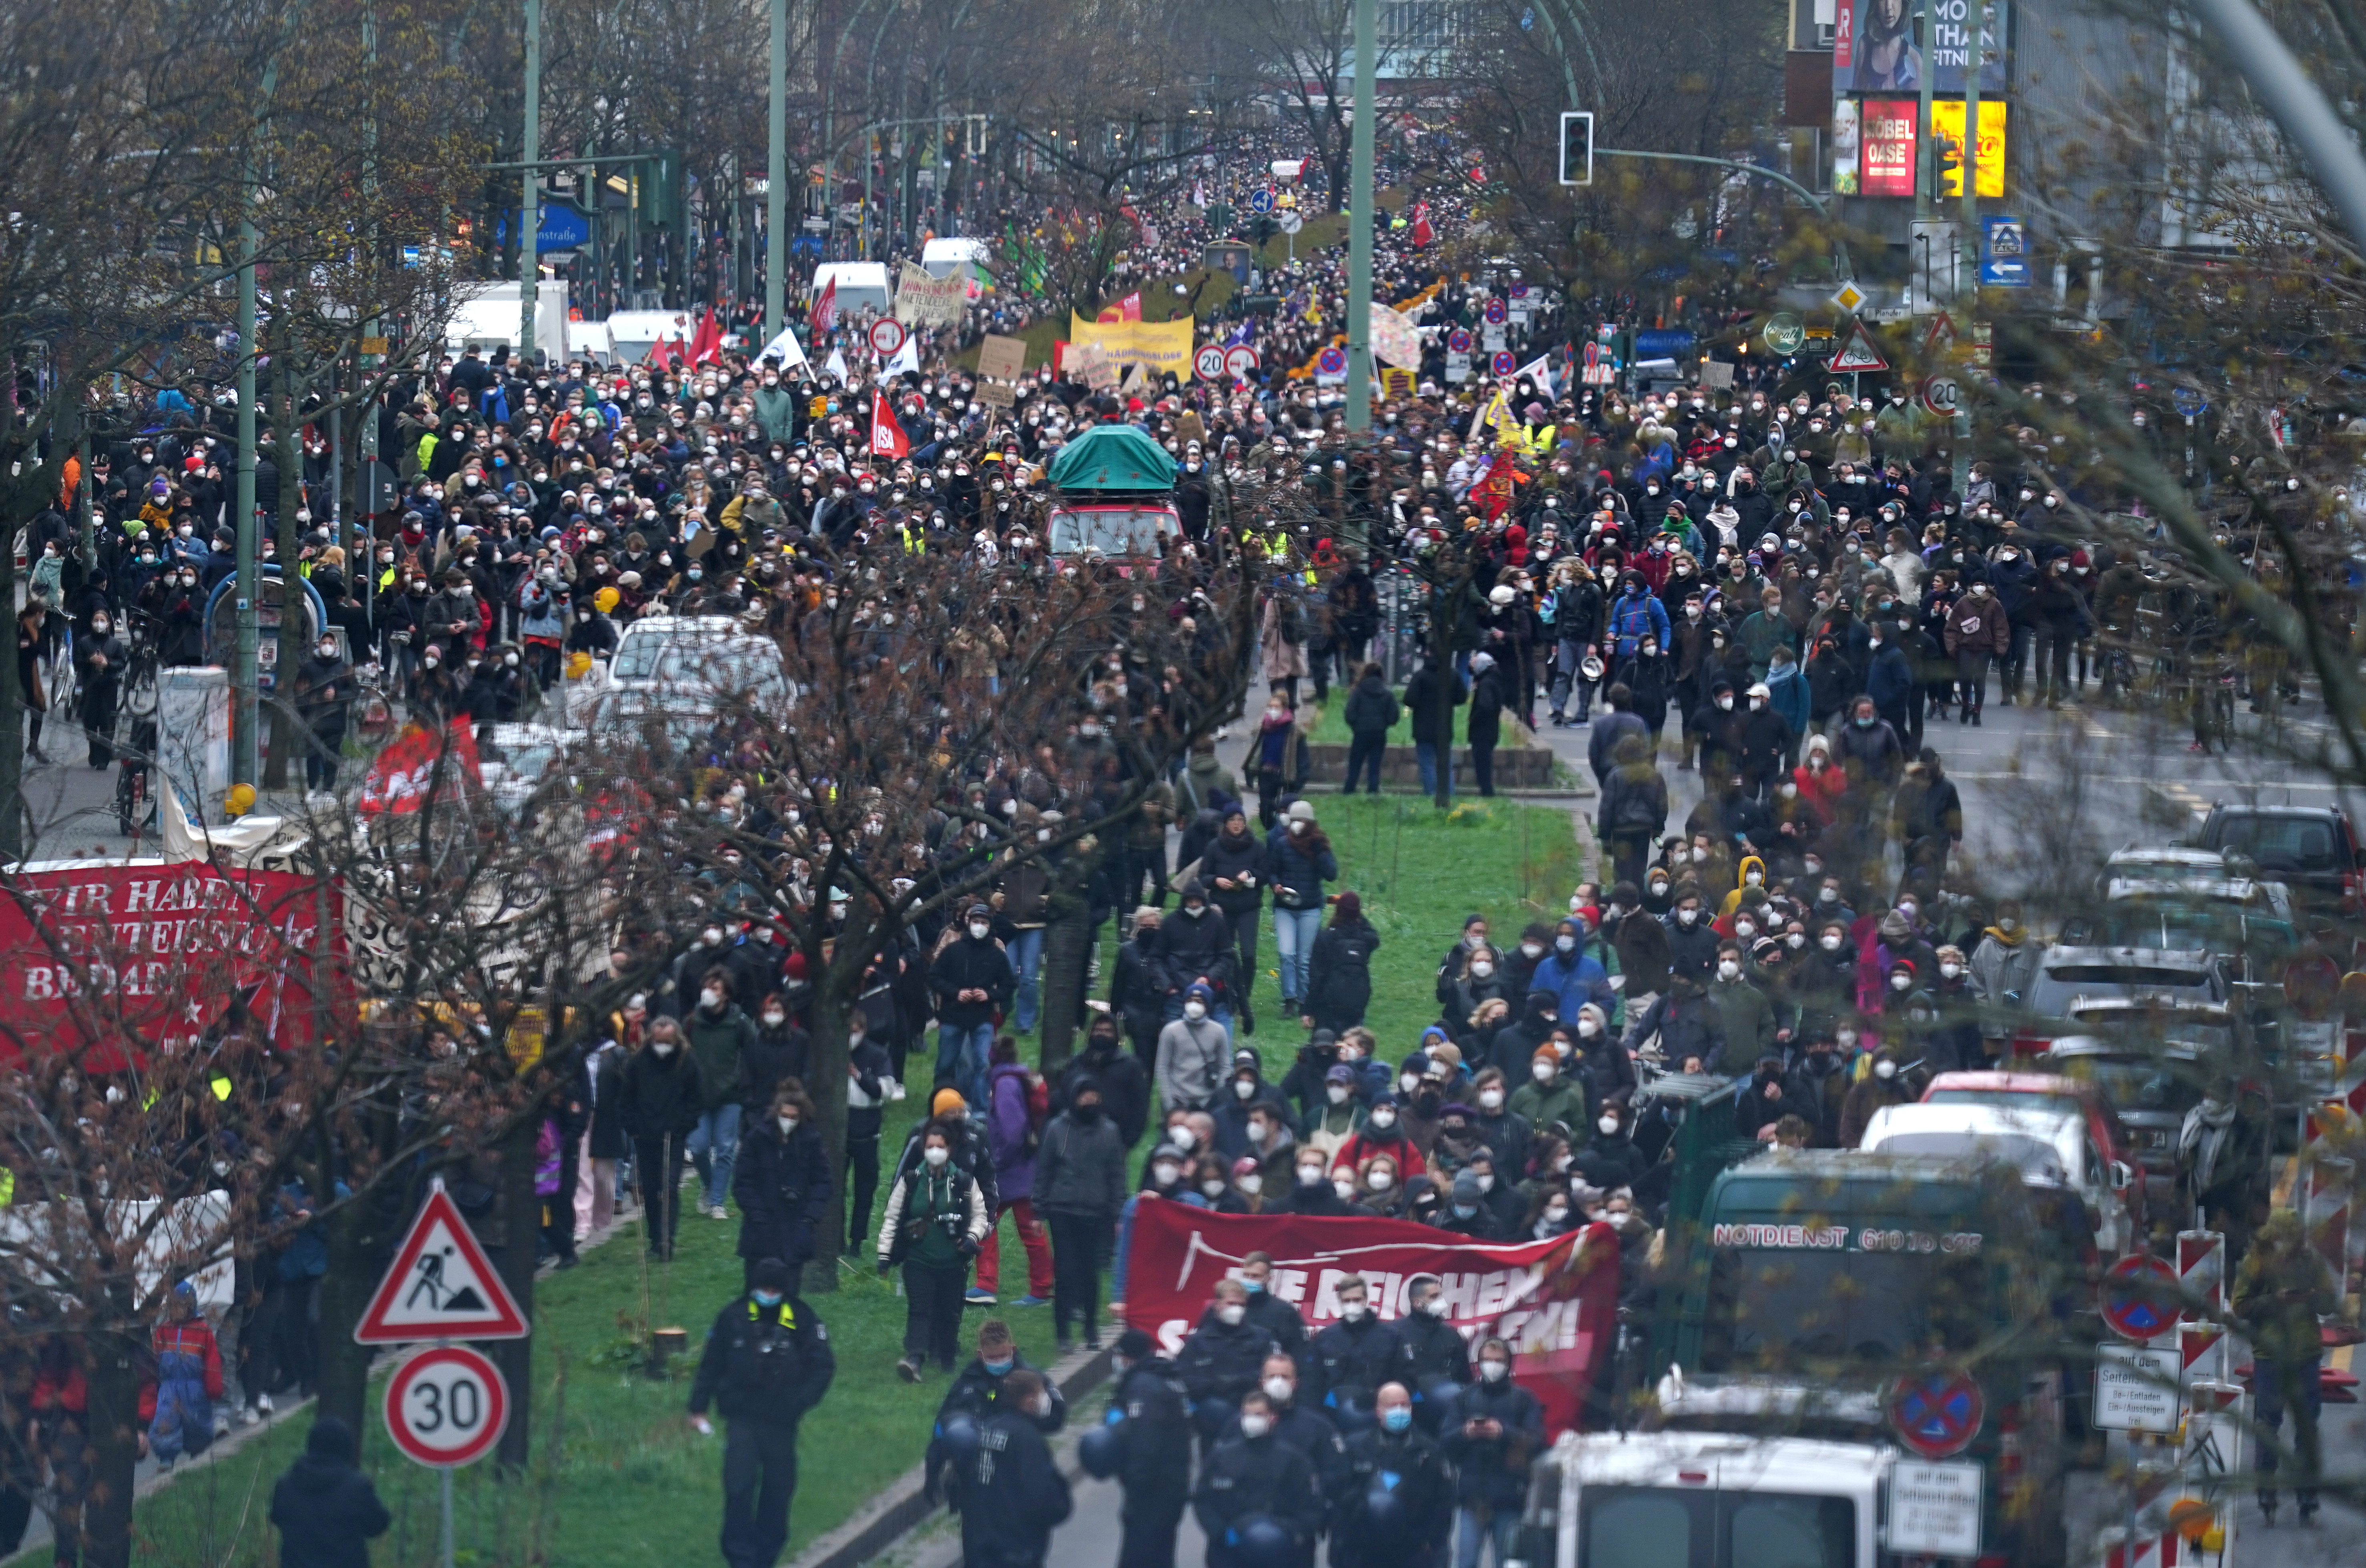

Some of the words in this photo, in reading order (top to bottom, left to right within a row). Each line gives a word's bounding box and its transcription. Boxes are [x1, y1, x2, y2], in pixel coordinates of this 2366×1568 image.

[1868, 143, 1906, 163] OASE
[1202, 355, 1221, 372] 20
[1933, 383, 1956, 404] 20
[1714, 1223, 1849, 1248] NOTDIENST
[2119, 1355, 2135, 1367] auf
[2139, 1356, 2160, 1368] dem
[413, 1380, 479, 1432] 30
[2108, 1403, 2165, 1415] Ein-/Aussteigen
[2128, 1416, 2141, 1426] frei
